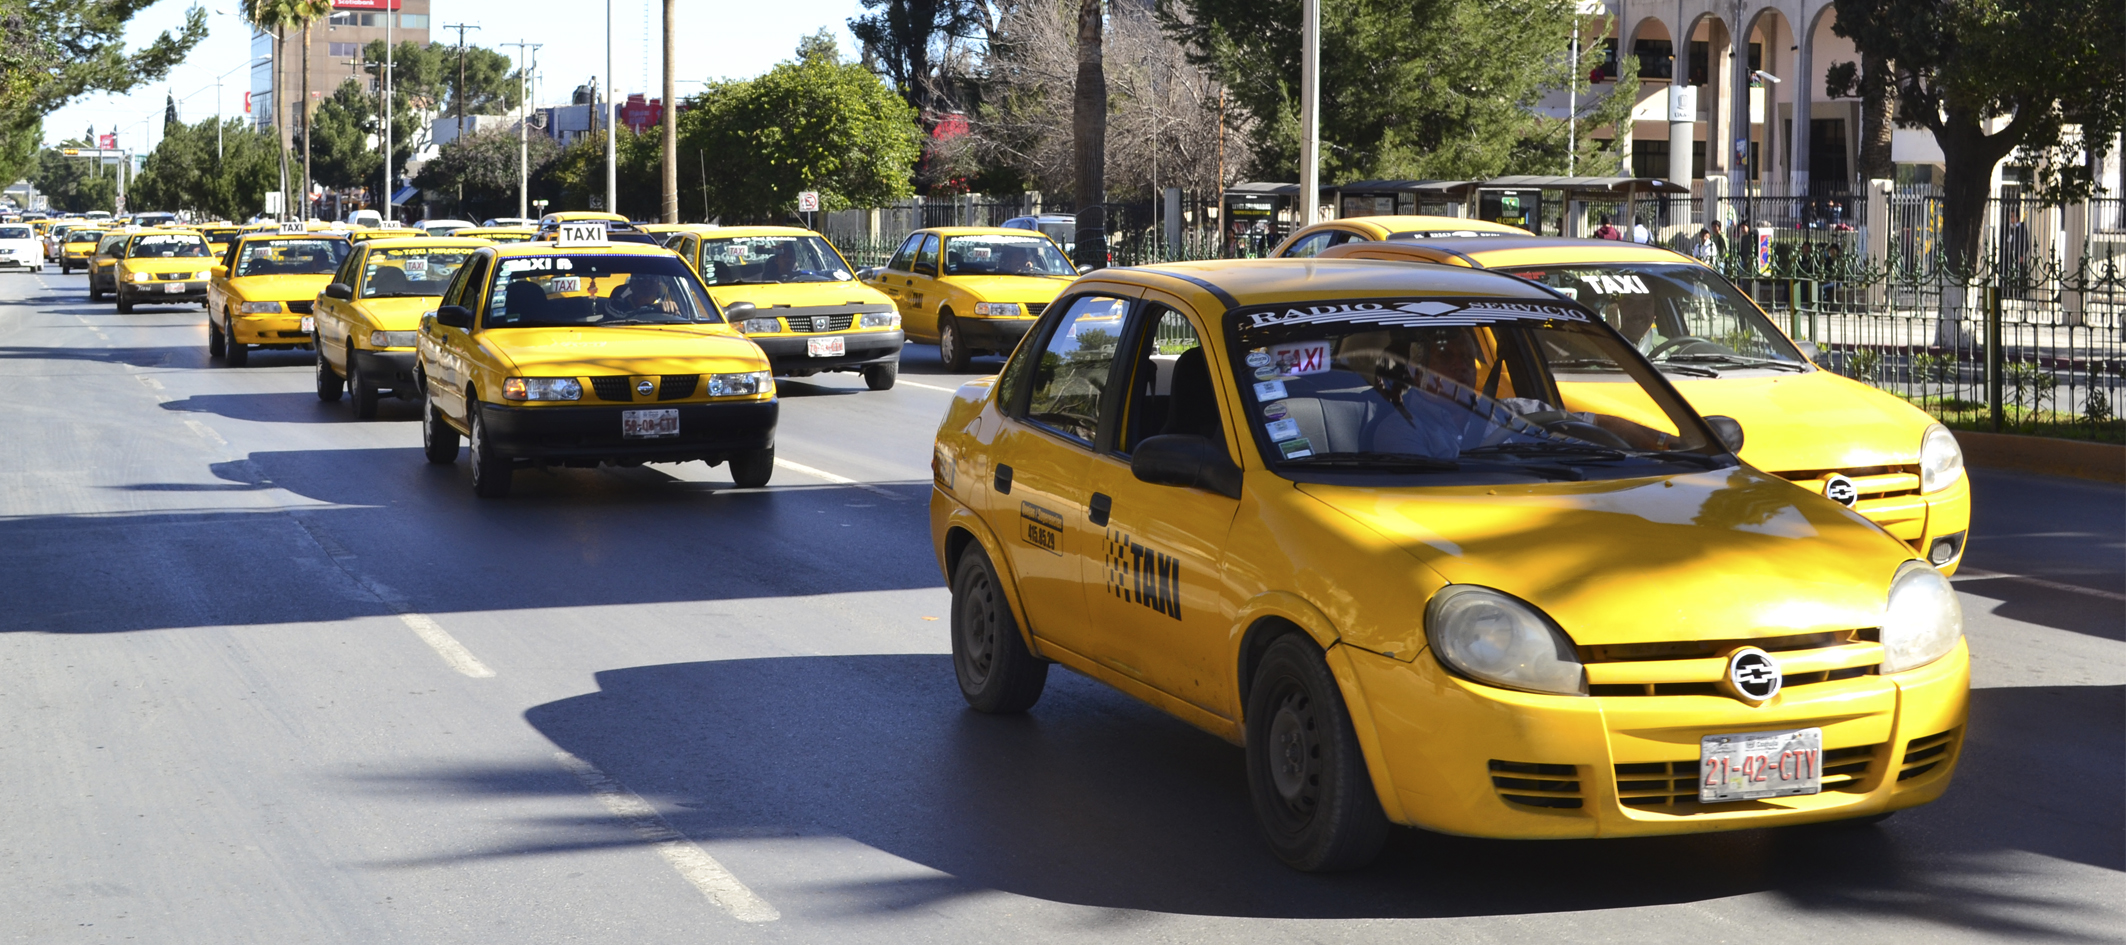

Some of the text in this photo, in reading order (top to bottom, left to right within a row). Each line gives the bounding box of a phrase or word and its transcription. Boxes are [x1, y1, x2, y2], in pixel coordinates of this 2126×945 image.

[282, 223, 304, 232] TAXI
[563, 227, 601, 241] TAXI
[730, 247, 745, 255] TAXI
[974, 250, 988, 258] TAXI
[407, 261, 424, 270] TAXI
[553, 280, 577, 292] TAXI
[1580, 275, 1650, 294] TAXI
[1248, 302, 1587, 325] RADIO SERVICIO
[1277, 347, 1324, 374] TAXI
[1130, 542, 1182, 621] TAXI
[1706, 748, 1817, 786] 21-42-CTY
